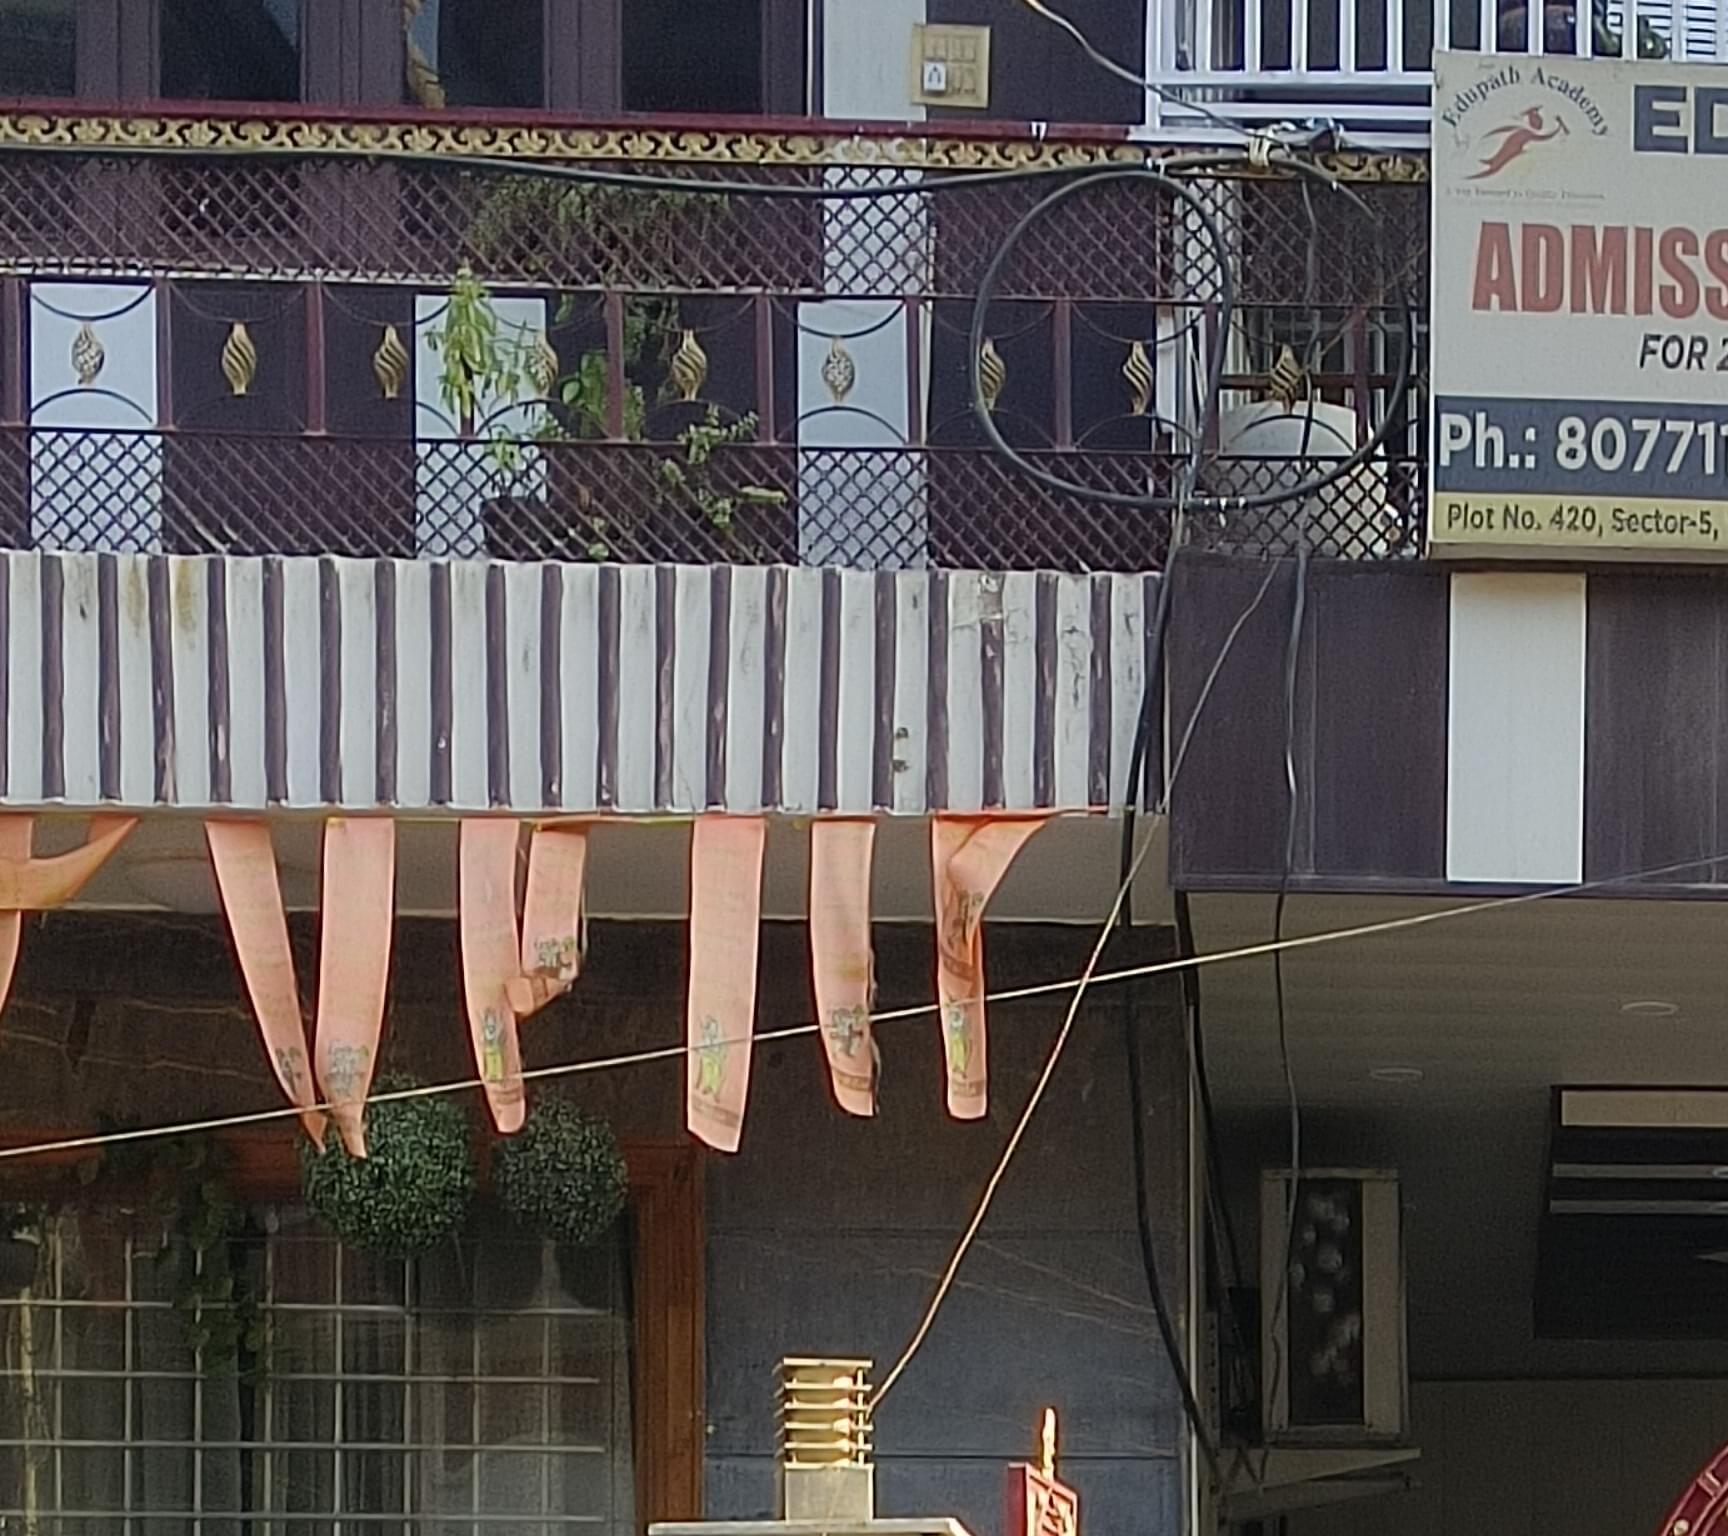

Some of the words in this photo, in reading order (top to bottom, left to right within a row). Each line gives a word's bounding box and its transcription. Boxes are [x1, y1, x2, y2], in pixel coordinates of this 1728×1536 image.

[1442, 65, 1520, 128] Edupath
[1530, 66, 1610, 136] Academy
[1638, 333, 1707, 370] FOR
[1439, 411, 1536, 469] Ph.:
[1448, 503, 1494, 530] Plot
[1503, 504, 1541, 531] No.
[1549, 505, 1604, 537] 420,
[1612, 509, 1719, 540] Sector-5,
